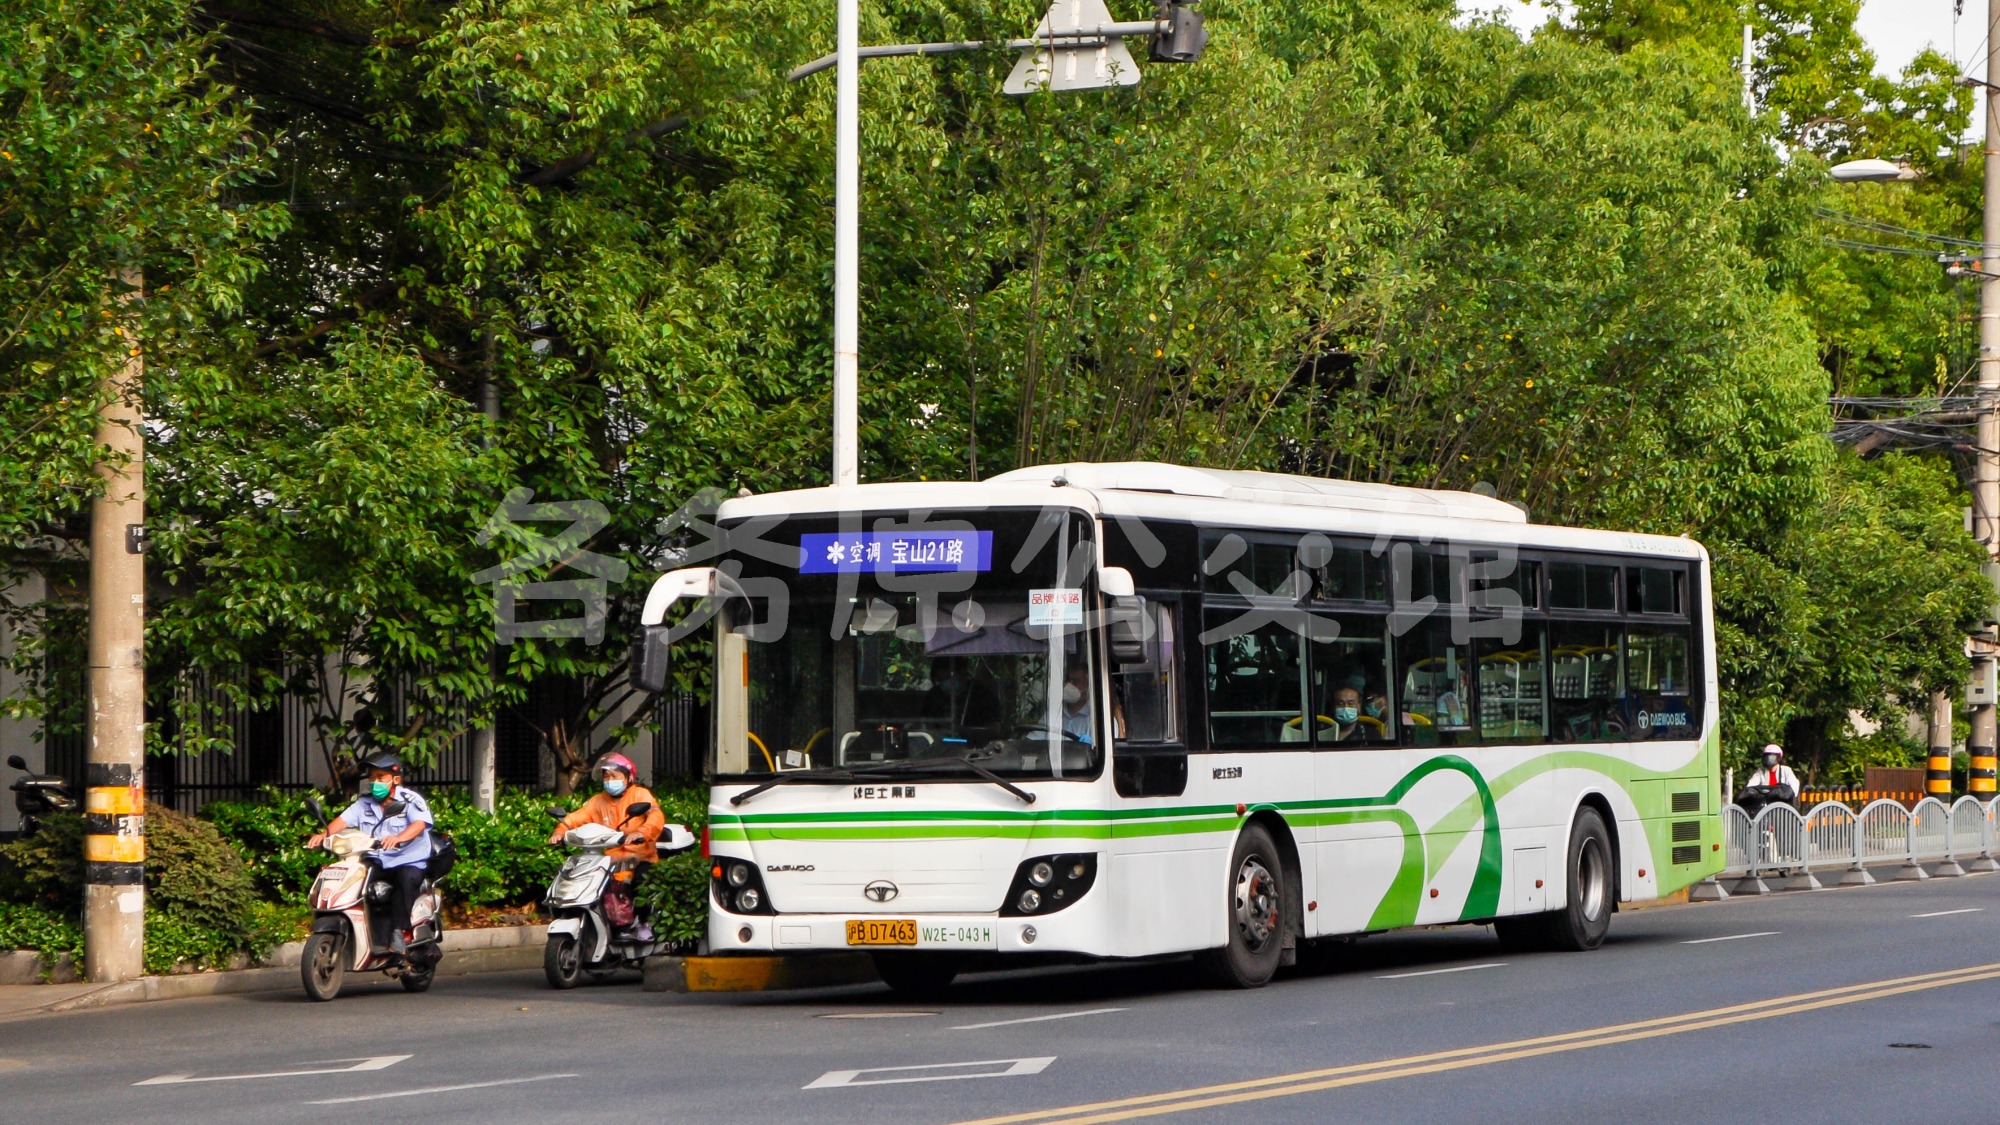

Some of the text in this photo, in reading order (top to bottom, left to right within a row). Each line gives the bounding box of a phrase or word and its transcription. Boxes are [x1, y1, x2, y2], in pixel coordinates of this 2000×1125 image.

[850, 539, 964, 564] 空调 宝山21路
[1650, 712, 1687, 726] DAEWOO BUS
[767, 864, 816, 872] DAEWOO
